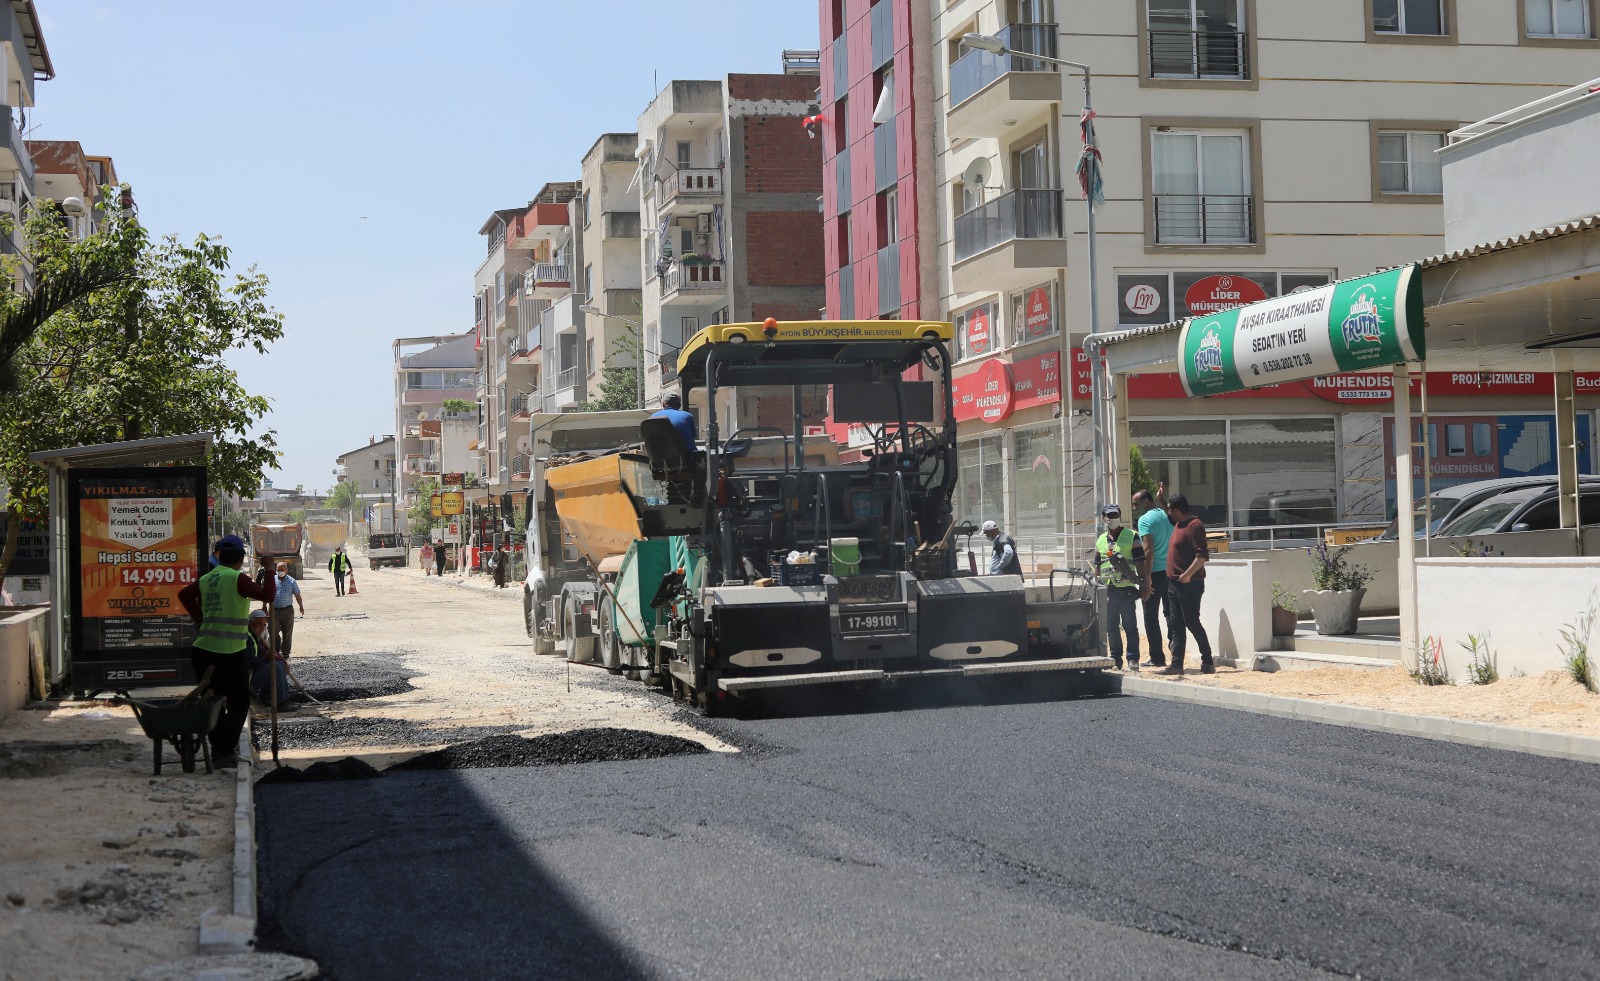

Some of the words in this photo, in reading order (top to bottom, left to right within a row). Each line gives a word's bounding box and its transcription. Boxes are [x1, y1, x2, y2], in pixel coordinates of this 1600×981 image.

[1211, 287, 1241, 299] LİDER
[1240, 312, 1266, 331] AVŞAR
[1266, 294, 1327, 324] KIRAATHANESİ
[802, 327, 862, 338] BÜYÜKŞEHİR
[1252, 332, 1286, 352] SEDAT'IN
[1287, 324, 1307, 345] YERİ
[1452, 373, 1480, 385] PROJ
[1576, 377, 1600, 387] Bud
[84, 486, 147, 495] YIKILMAZ
[142, 505, 167, 513] Odası
[111, 518, 138, 526] Koltuk
[141, 518, 169, 526] Takımı
[114, 531, 137, 539] Yatak
[98, 551, 131, 566] Hepsi
[134, 550, 177, 562] Sadece
[122, 568, 175, 584] 14.990
[179, 567, 196, 583] tl.
[108, 598, 170, 608] YIKILMAZ
[847, 615, 897, 629] 17-99101
[106, 670, 144, 680] ZEUS
